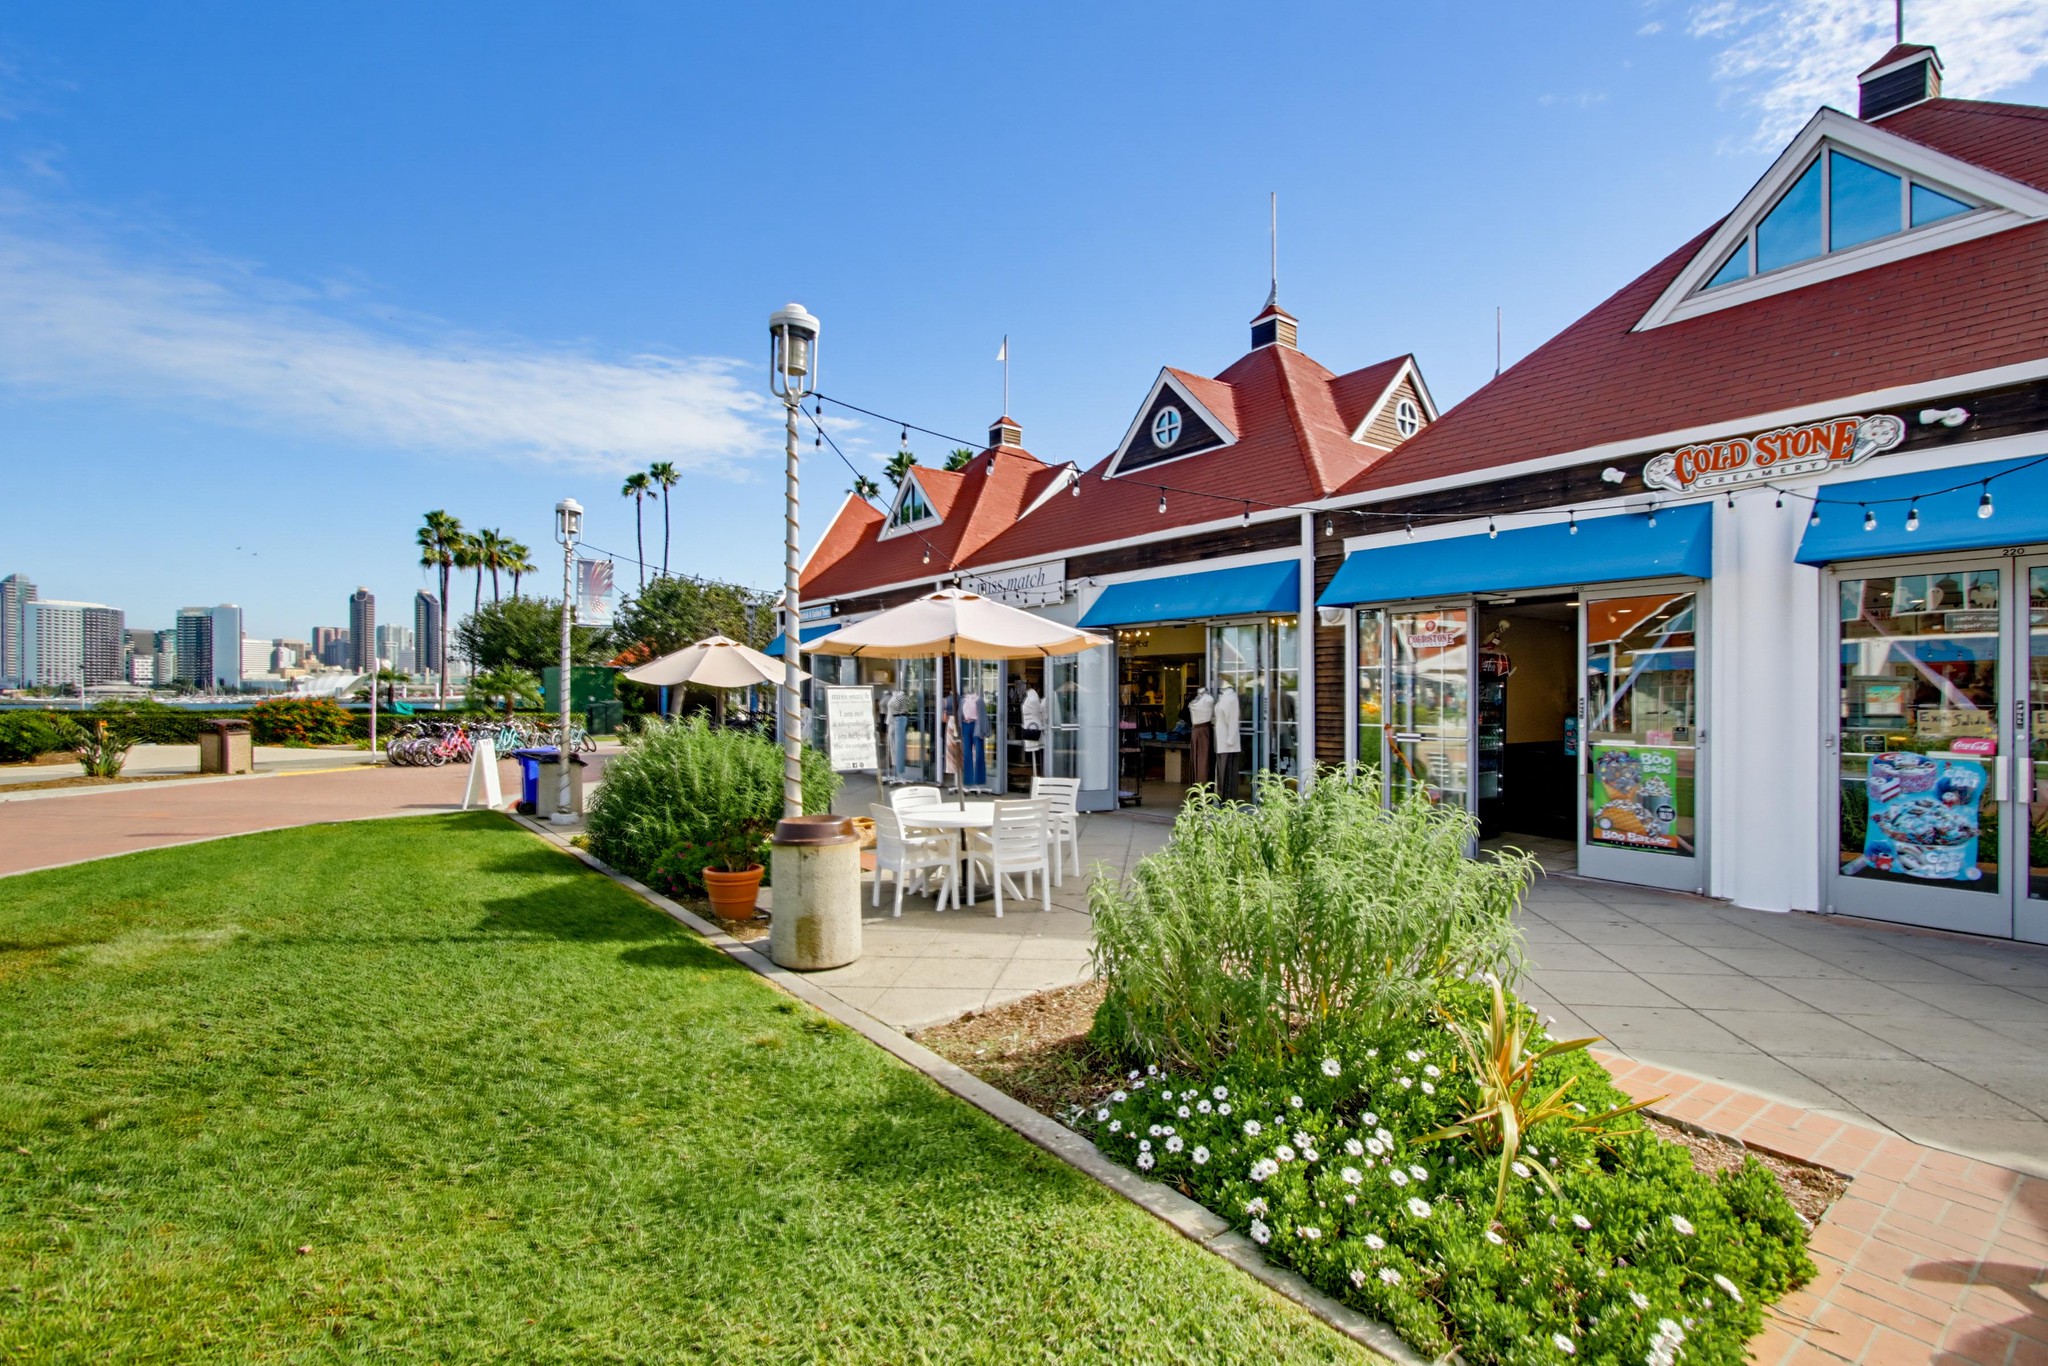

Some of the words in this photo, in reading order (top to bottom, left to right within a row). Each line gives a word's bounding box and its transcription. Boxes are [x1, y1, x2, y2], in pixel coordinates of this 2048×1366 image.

[1674, 441, 1748, 484] COLD
[1755, 420, 1858, 467] STONE
[1703, 462, 1819, 486] CREAMERY
[2002, 547, 2025, 557] 220
[1006, 567, 1046, 591] match
[1640, 752, 1672, 766] Boo
[1601, 830, 1626, 841] Boo
